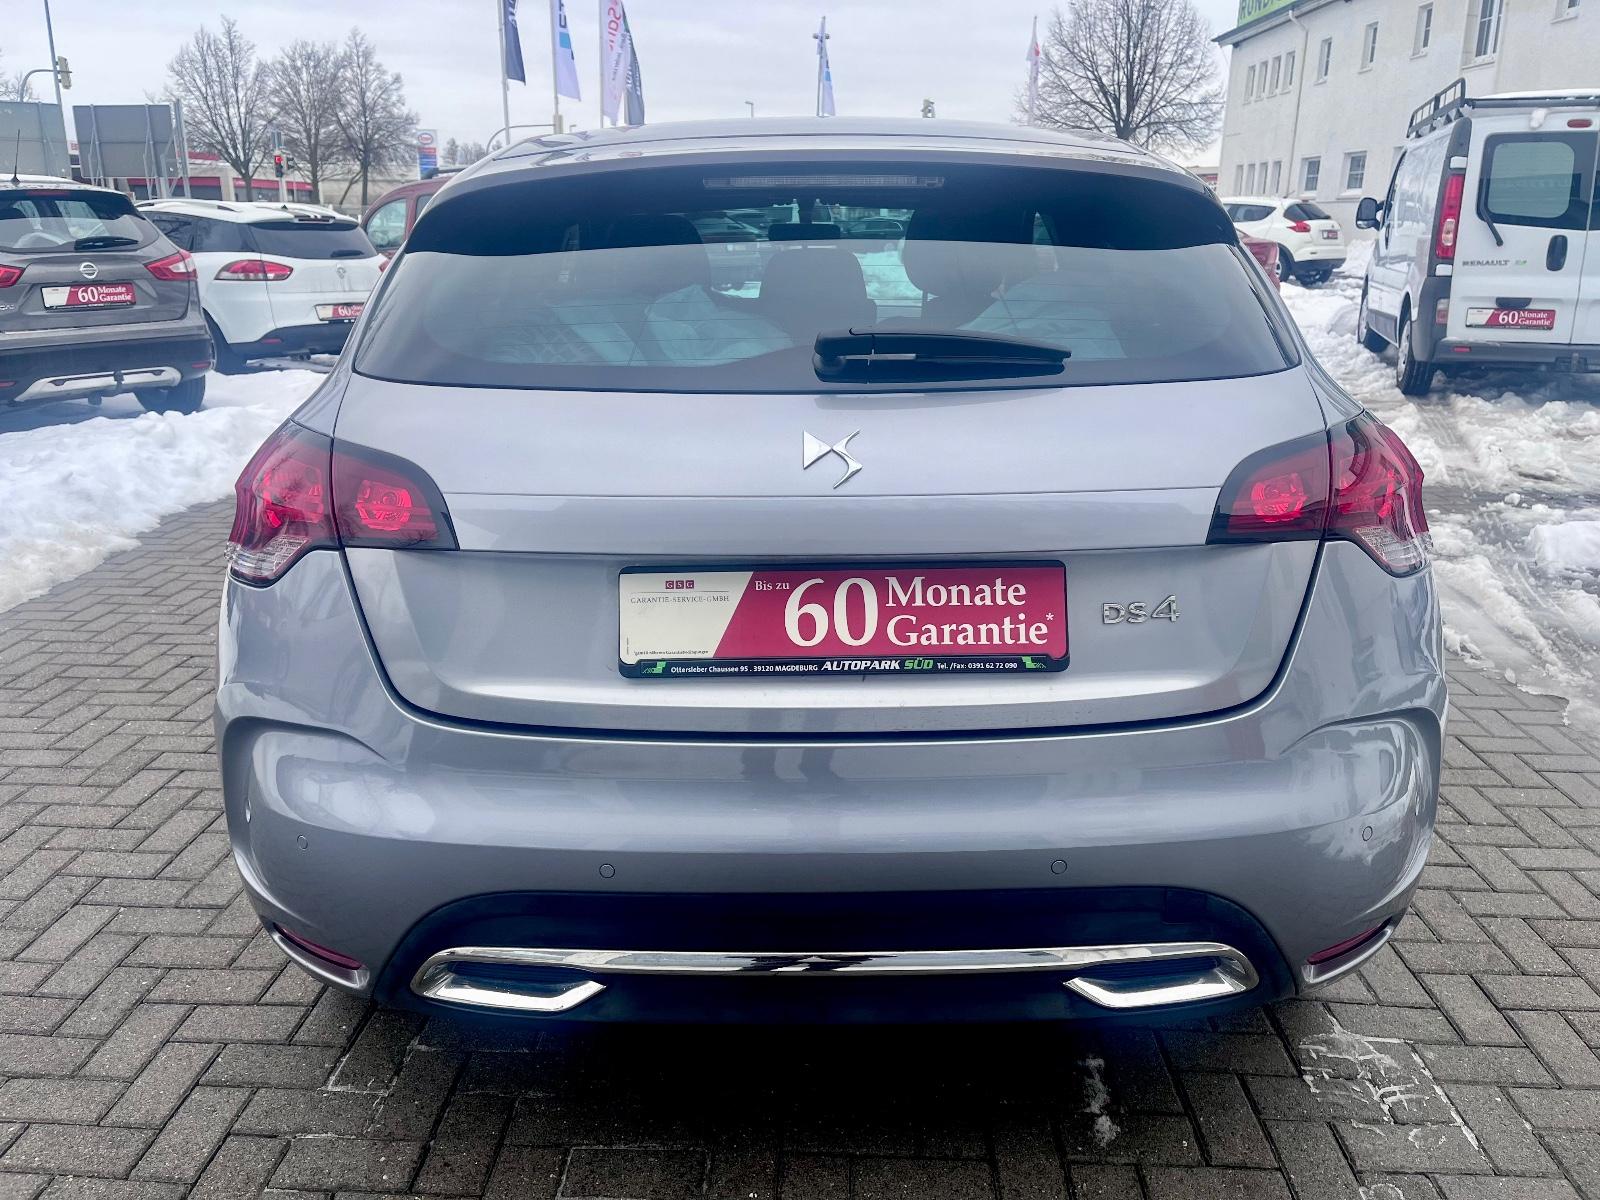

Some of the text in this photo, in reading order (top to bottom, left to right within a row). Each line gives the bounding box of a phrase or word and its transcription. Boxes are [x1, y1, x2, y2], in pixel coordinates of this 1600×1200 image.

[78, 286, 98, 302] 60
[338, 305, 352, 316] 60
[1499, 310, 1548, 324] 60 Monate
[665, 580, 694, 589] GSG
[754, 580, 790, 590] Bis zu
[885, 576, 1027, 607] Monate
[784, 577, 878, 647] 60
[708, 665, 739, 673] Chaussee
[774, 664, 818, 672] MAGDEBURG
[821, 658, 934, 671] AUTOPARK SÜD
